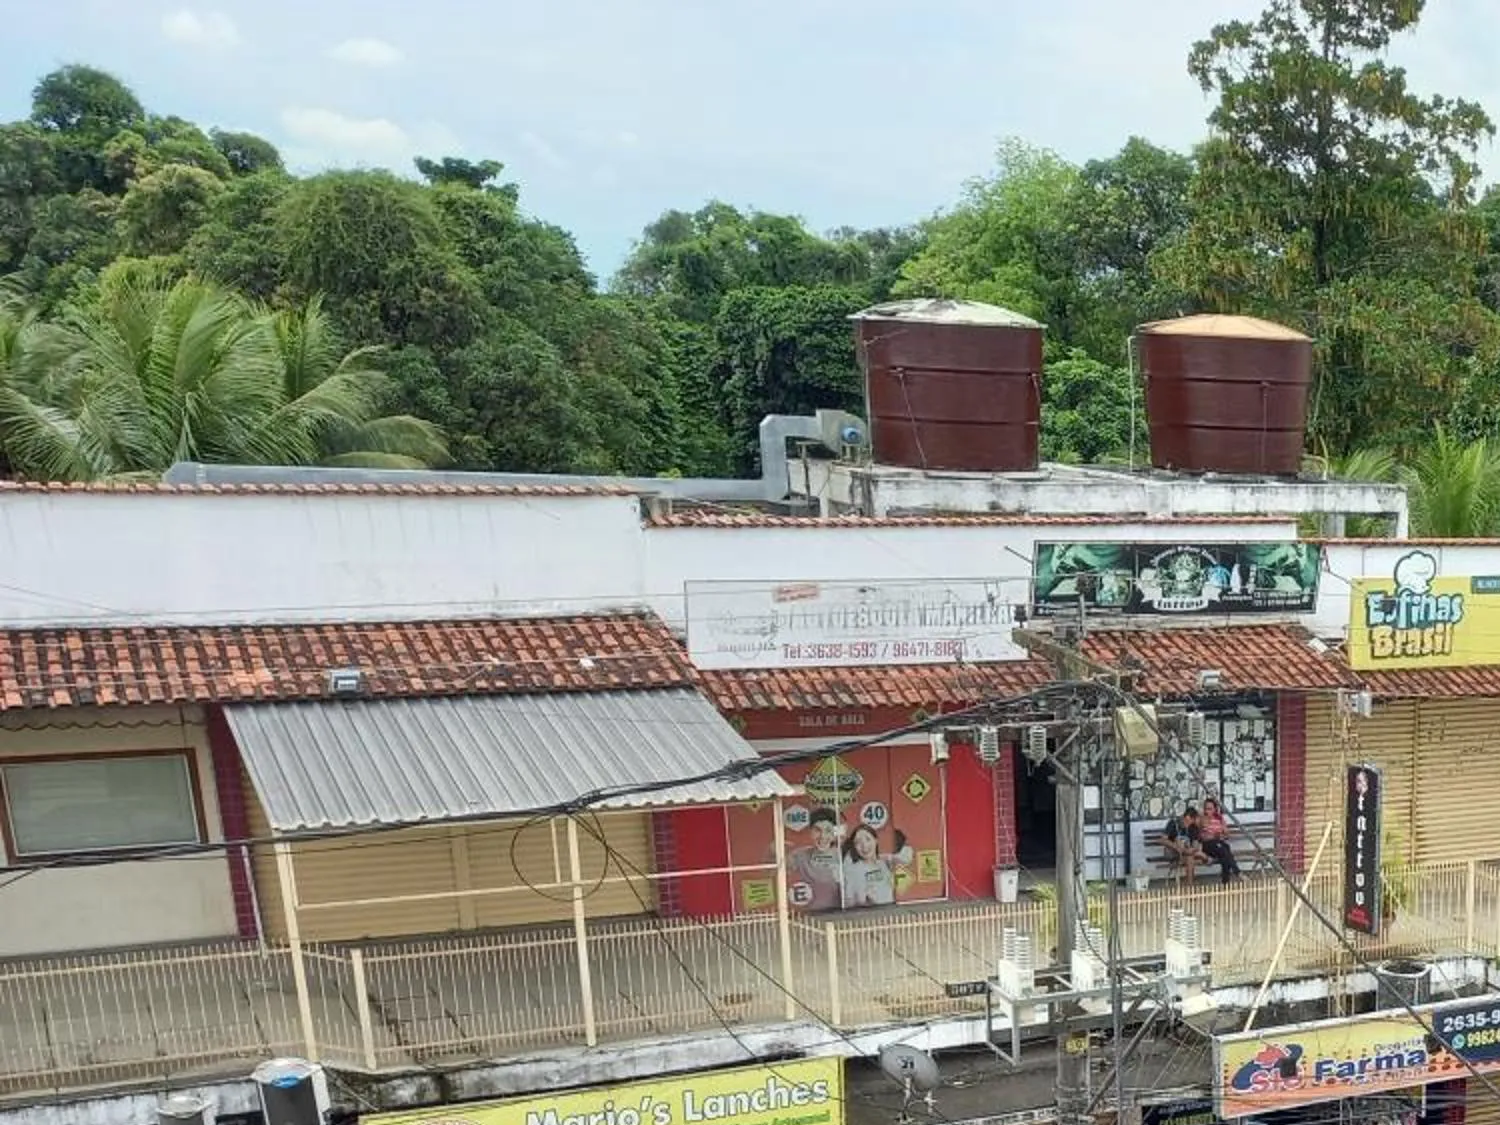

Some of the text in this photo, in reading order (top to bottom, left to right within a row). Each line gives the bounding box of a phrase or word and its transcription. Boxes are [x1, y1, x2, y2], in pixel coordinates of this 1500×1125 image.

[1371, 624, 1455, 659] Brasil
[863, 805, 885, 819] 40
[1314, 1048, 1428, 1083] Farma
[683, 1076, 829, 1122] Lanches
